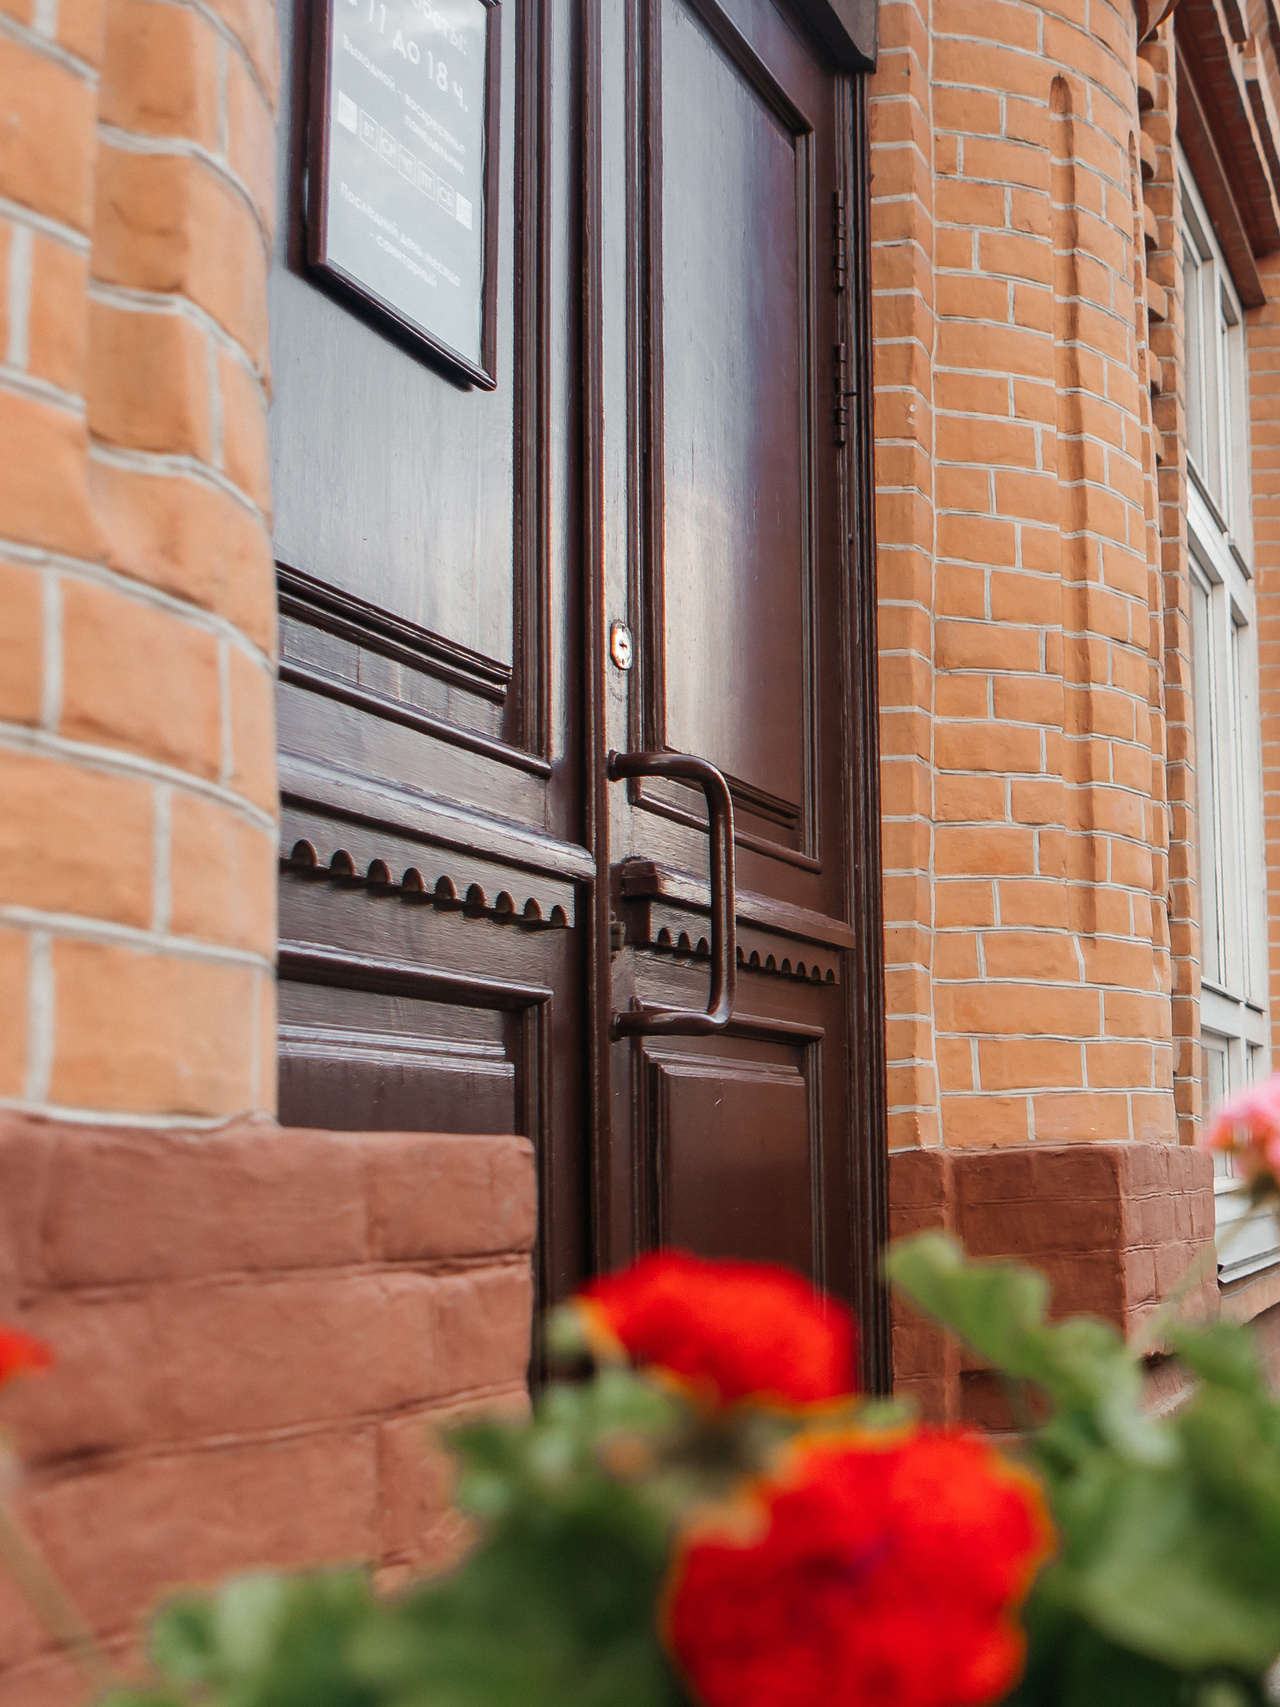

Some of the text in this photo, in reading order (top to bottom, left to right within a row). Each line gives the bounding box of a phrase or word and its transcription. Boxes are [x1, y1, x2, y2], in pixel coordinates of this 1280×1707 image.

[343, 34, 396, 92] Выходной
[405, 93, 466, 157] воскресенье
[427, 50, 448, 92] 18
[363, 121, 376, 139] ВТ
[401, 156, 414, 175] ЧТ
[439, 186, 453, 206] СБ
[405, 114, 466, 176] понедельник
[340, 181, 461, 288] Последний день месяца
[377, 235, 438, 289] санитарный
